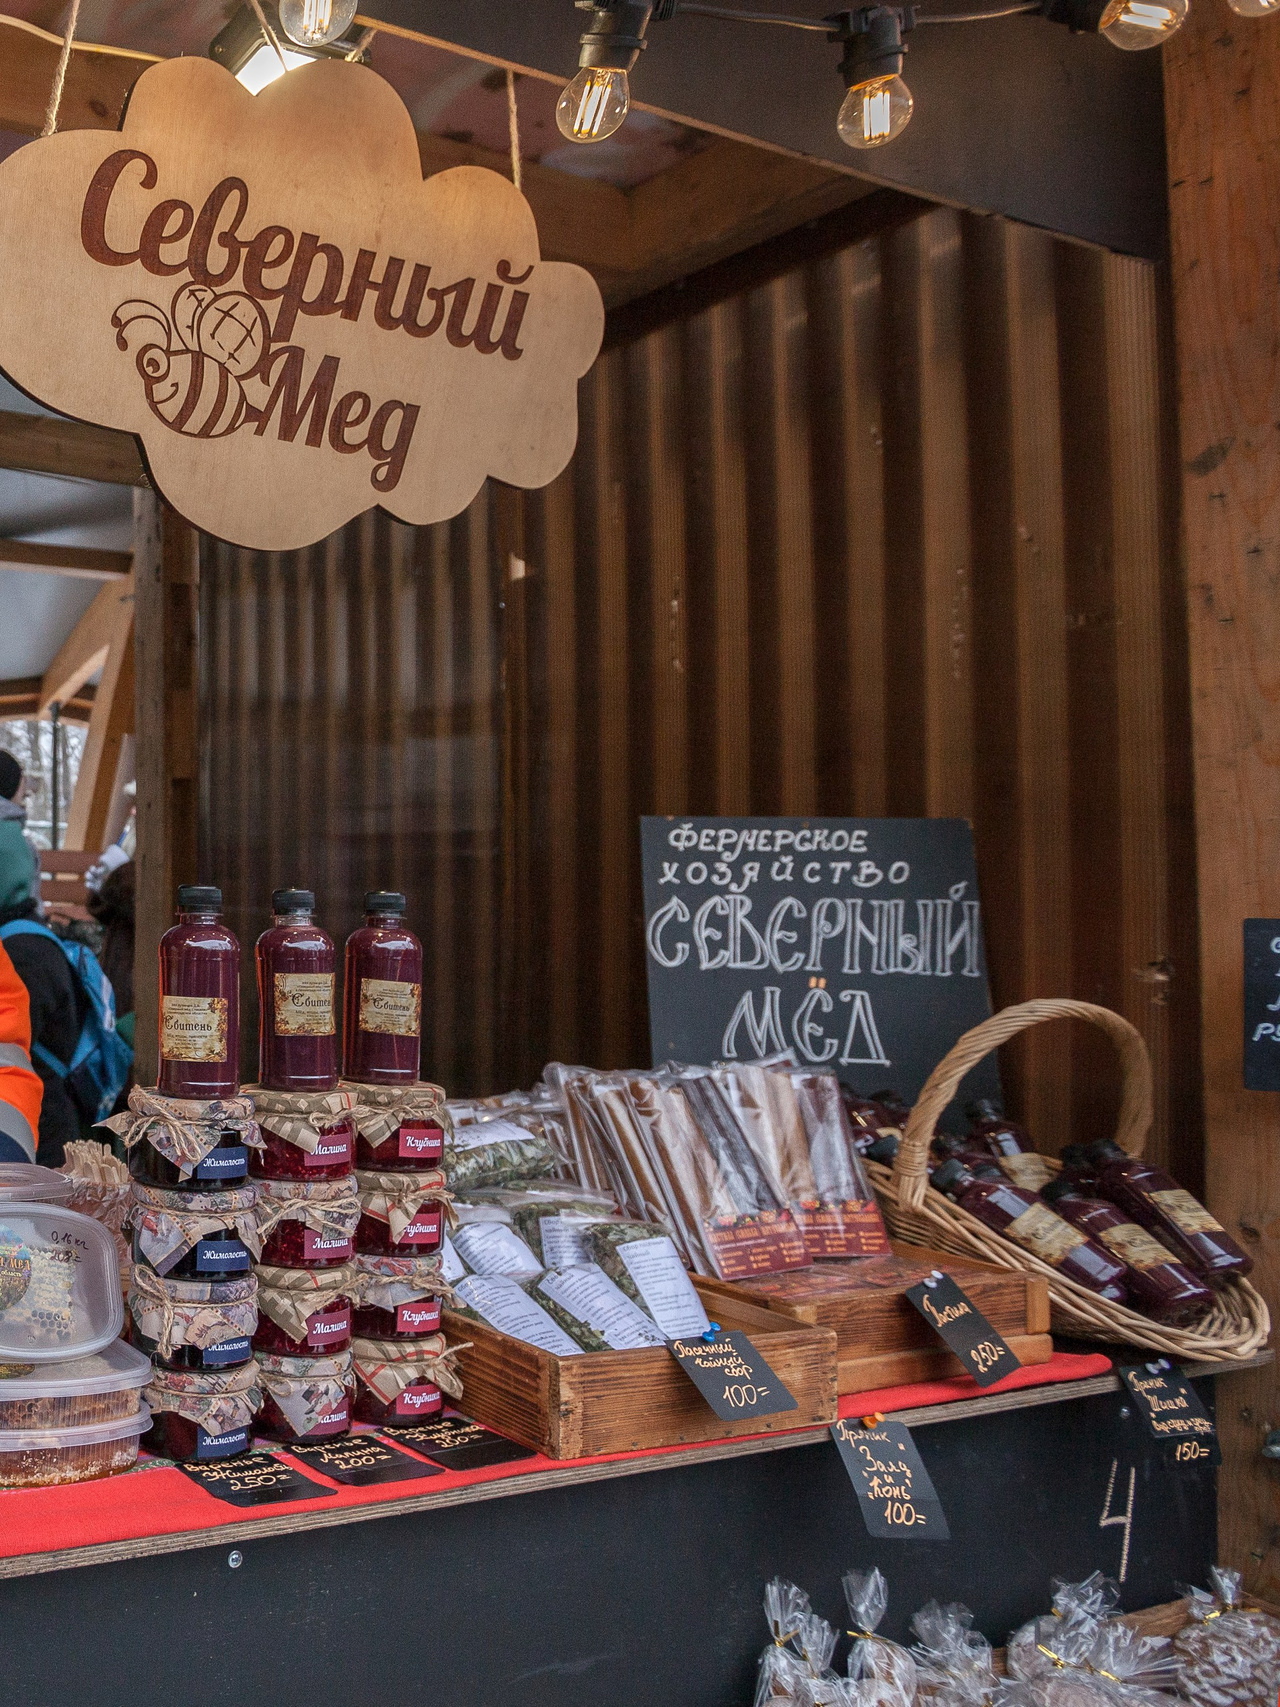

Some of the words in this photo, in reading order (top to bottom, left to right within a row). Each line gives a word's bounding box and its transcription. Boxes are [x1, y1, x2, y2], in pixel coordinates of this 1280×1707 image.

[80, 149, 534, 361] Северный
[256, 346, 421, 493] Мед
[668, 824, 868, 860] ФЕРМЕРСКОЕ
[659, 858, 910, 892] ХОЗЯЙСТВО
[646, 881, 982, 977] СЕВЕРНЫЙ
[164, 1014, 212, 1031] Сбитень
[310, 1143, 347, 1155] Малина
[406, 1136, 441, 1151] Клубника
[203, 1156, 245, 1168] Жимолость
[404, 1223, 437, 1237] лубника
[312, 1237, 348, 1250] Малина
[203, 1249, 247, 1261] Жимолость
[402, 1309, 439, 1324] Клубника
[922, 1294, 973, 1327] Пастила
[312, 1319, 347, 1335] Малина
[674, 1338, 736, 1358] Пасечный
[695, 1353, 745, 1368] чайный
[724, 1365, 753, 1380] сбор
[403, 1391, 441, 1407] Клубника
[321, 1410, 347, 1424] алина
[383, 1421, 454, 1436] Варенье
[836, 1419, 891, 1448] Пряник
[203, 1432, 246, 1446] Жимолость
[291, 1439, 368, 1454] Варенье
[183, 1457, 269, 1472] Варенье
[1099, 1457, 1136, 1582] 4
